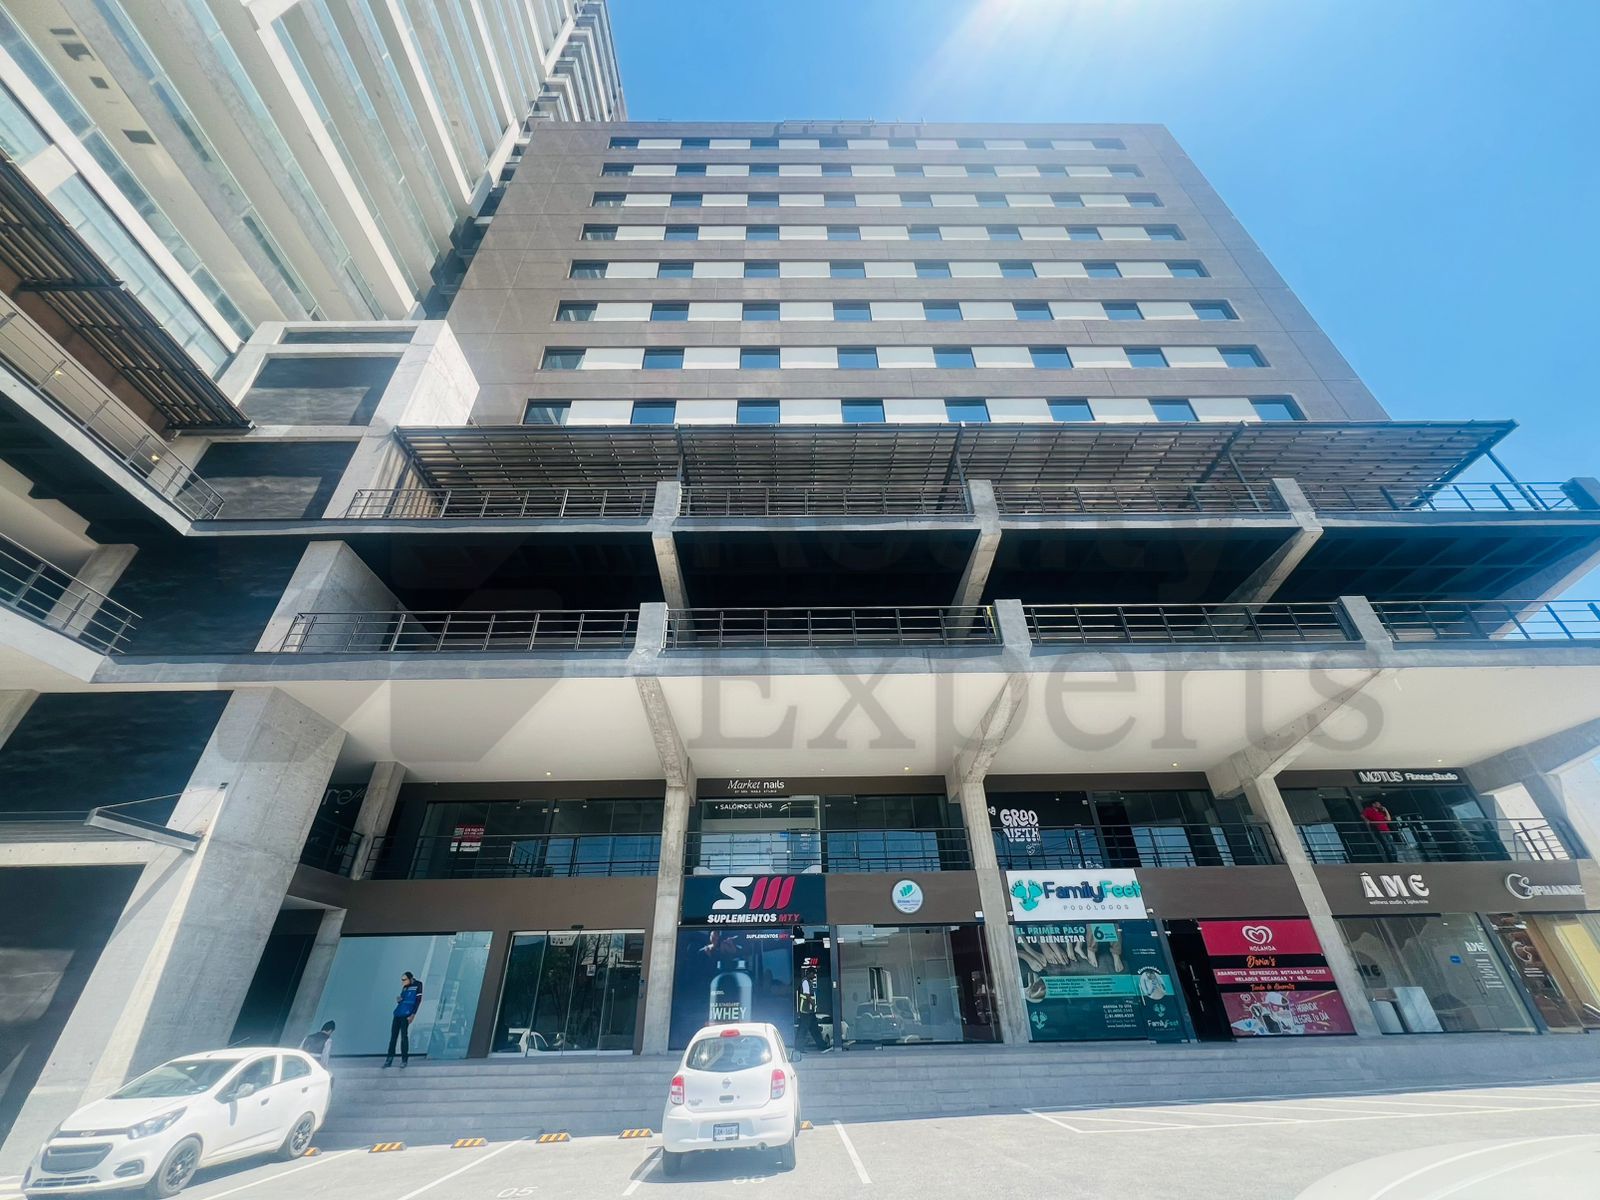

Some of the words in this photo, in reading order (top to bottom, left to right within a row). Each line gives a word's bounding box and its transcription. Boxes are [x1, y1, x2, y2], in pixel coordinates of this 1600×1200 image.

[727, 780, 761, 789] Market
[763, 780, 785, 789] nails
[754, 801, 773, 809] UÑAS
[707, 913, 777, 923] SUPLEMENTOS
[779, 913, 801, 922] MTY
[1016, 927, 1025, 935] EL
[1028, 927, 1060, 935] PRIMER
[1063, 926, 1086, 934] PASO
[1093, 926, 1105, 941] 6
[1017, 936, 1025, 944] A
[1040, 935, 1086, 943] BIENESTAR
[712, 1007, 747, 1020] WHEY
[496, 1186, 538, 1198] 05
